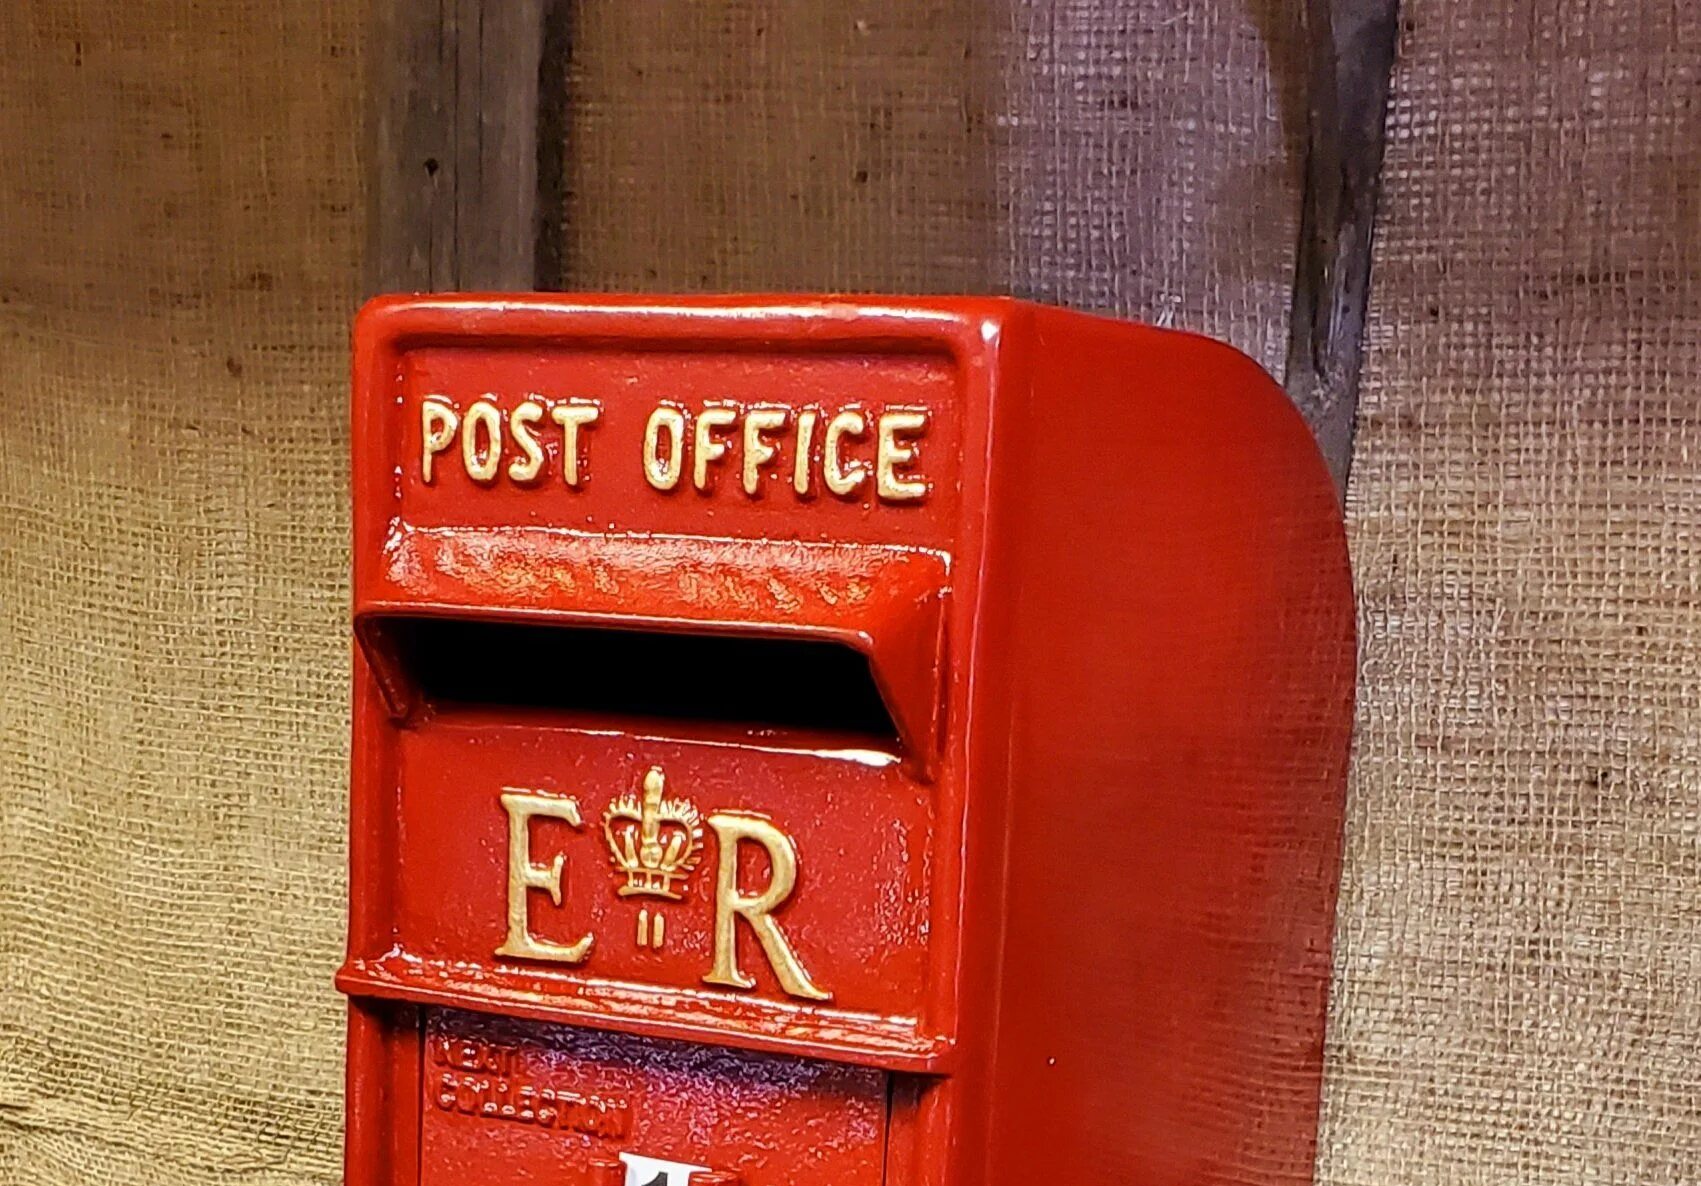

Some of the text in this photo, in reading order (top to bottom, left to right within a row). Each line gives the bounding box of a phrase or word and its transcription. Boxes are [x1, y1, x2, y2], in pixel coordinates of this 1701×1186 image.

[422, 398, 927, 499] POST OFFICE
[494, 792, 832, 1000] E R
